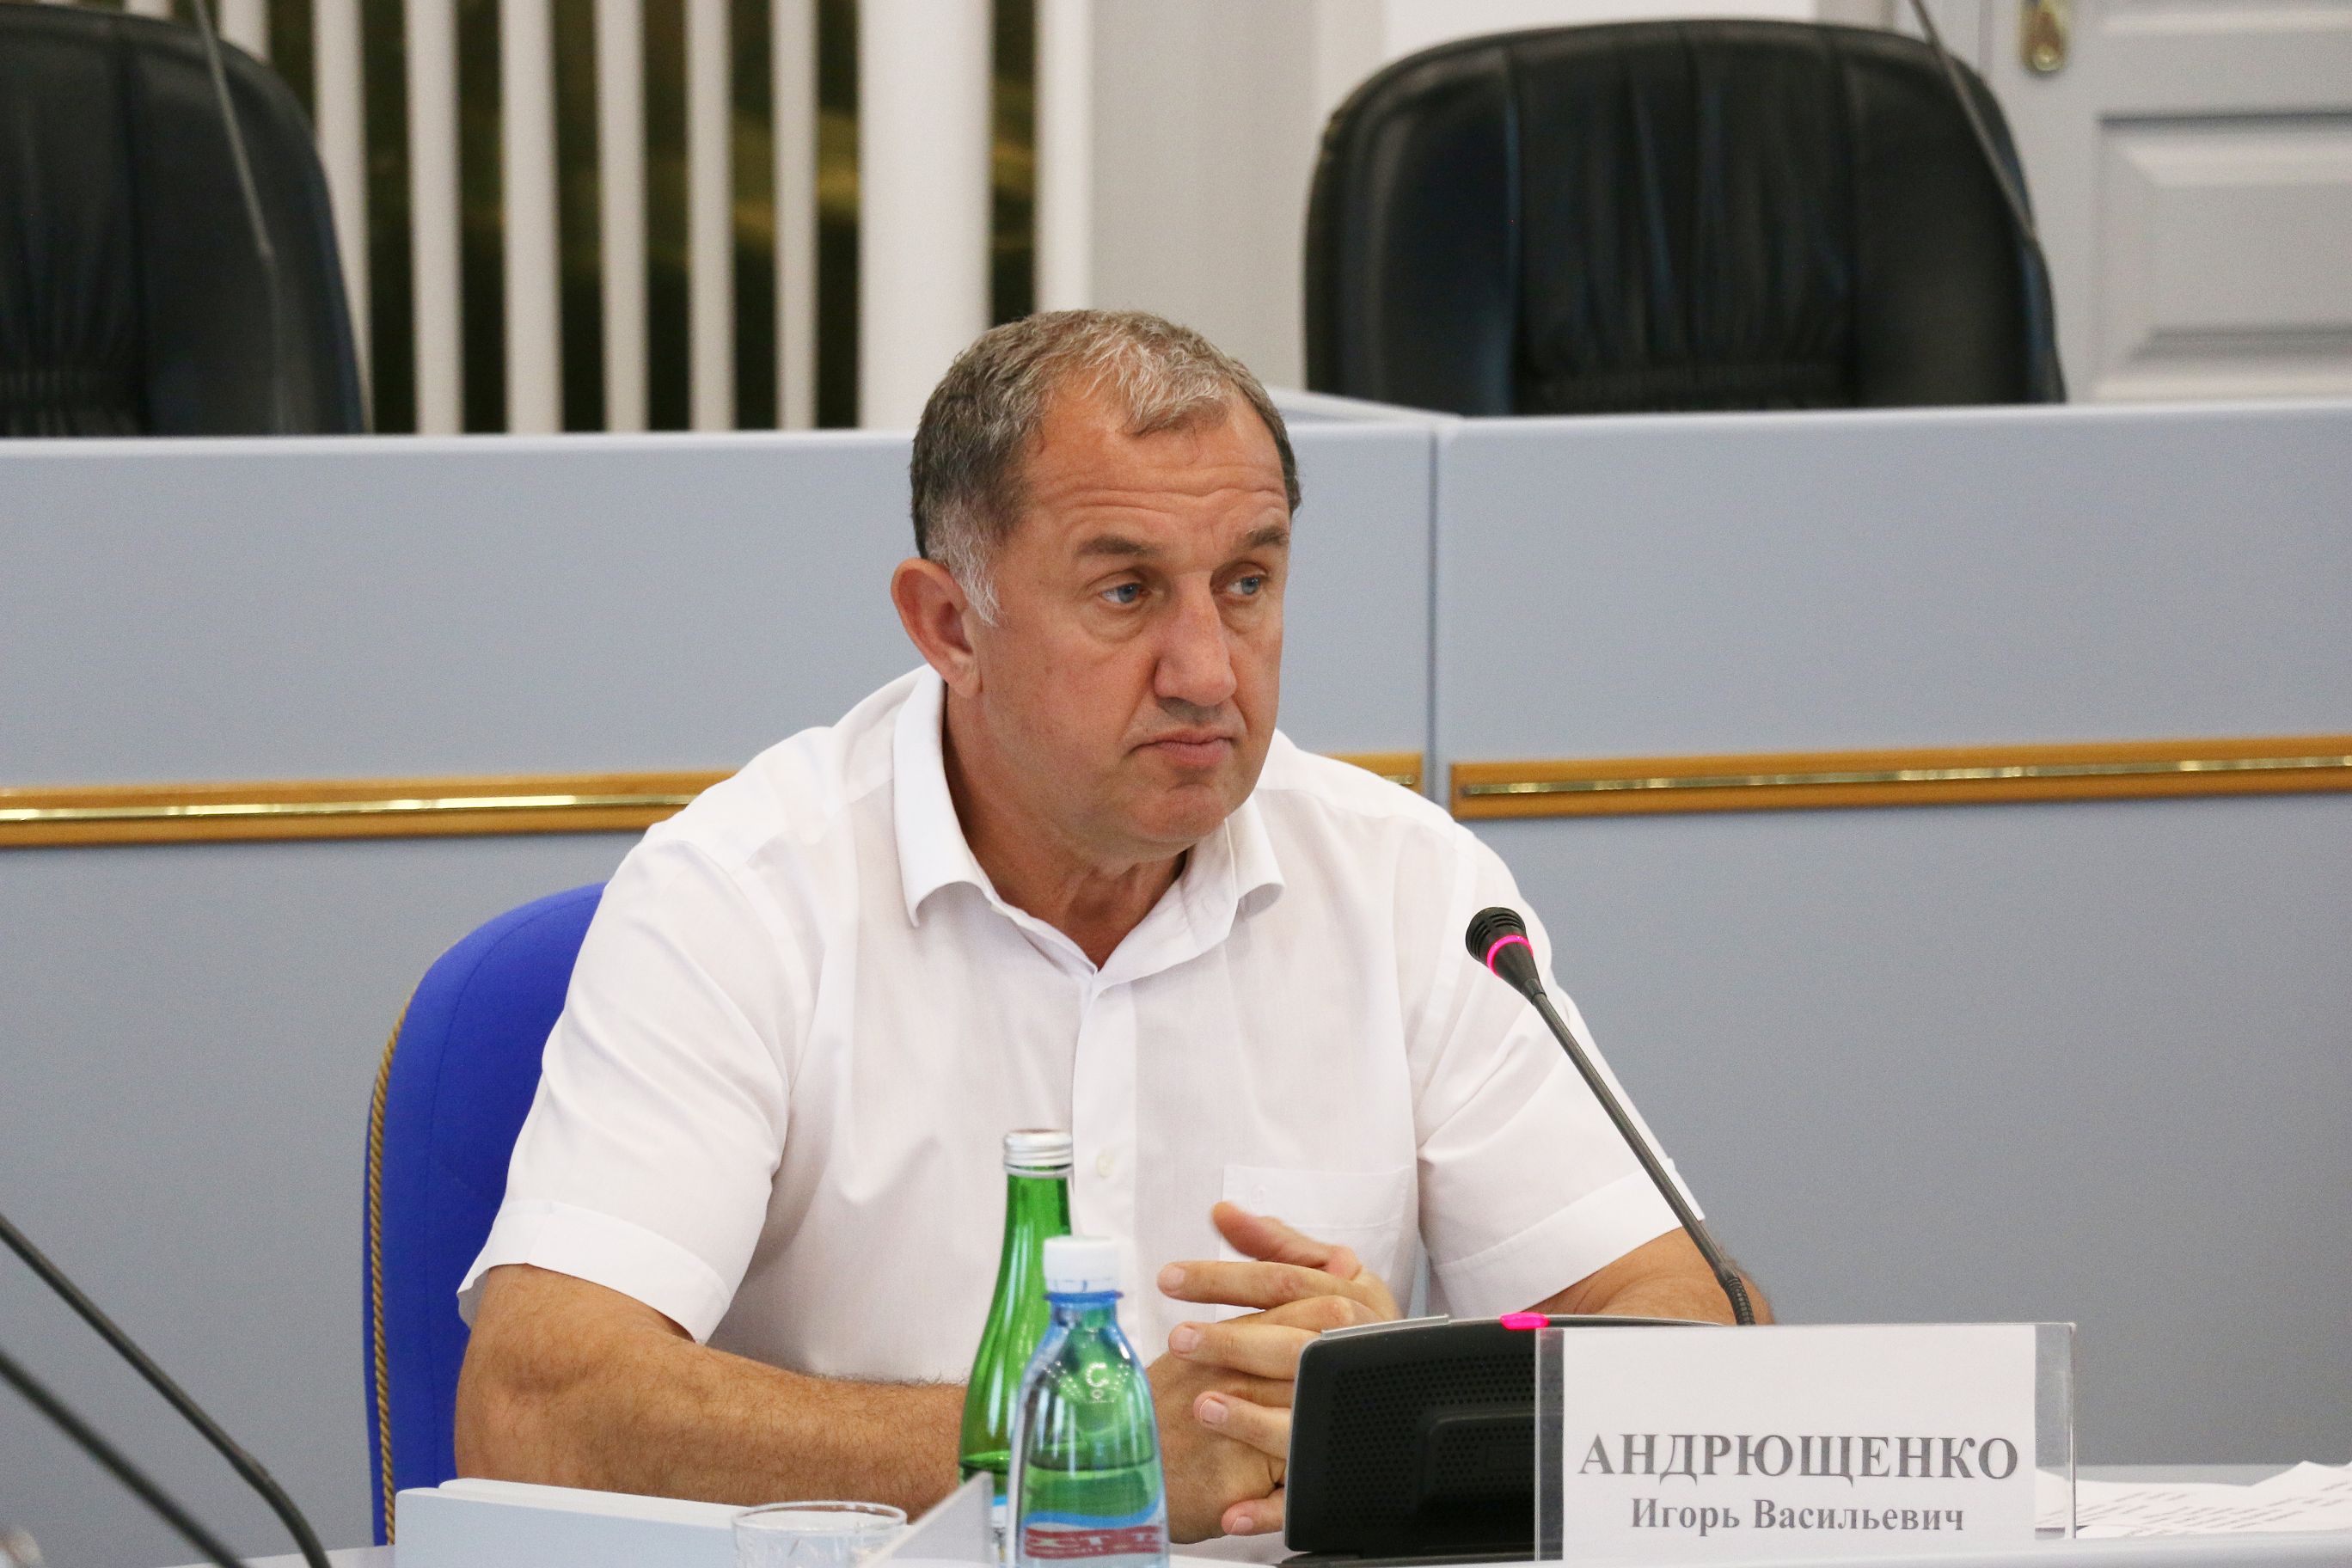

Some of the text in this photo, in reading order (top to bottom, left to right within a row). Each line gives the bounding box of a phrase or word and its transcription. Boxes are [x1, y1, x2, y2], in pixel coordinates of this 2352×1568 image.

[1577, 1434, 2018, 1486] АНДРЮЩЕНКО
[1632, 1498, 1964, 1537] Игорь Васильевич
